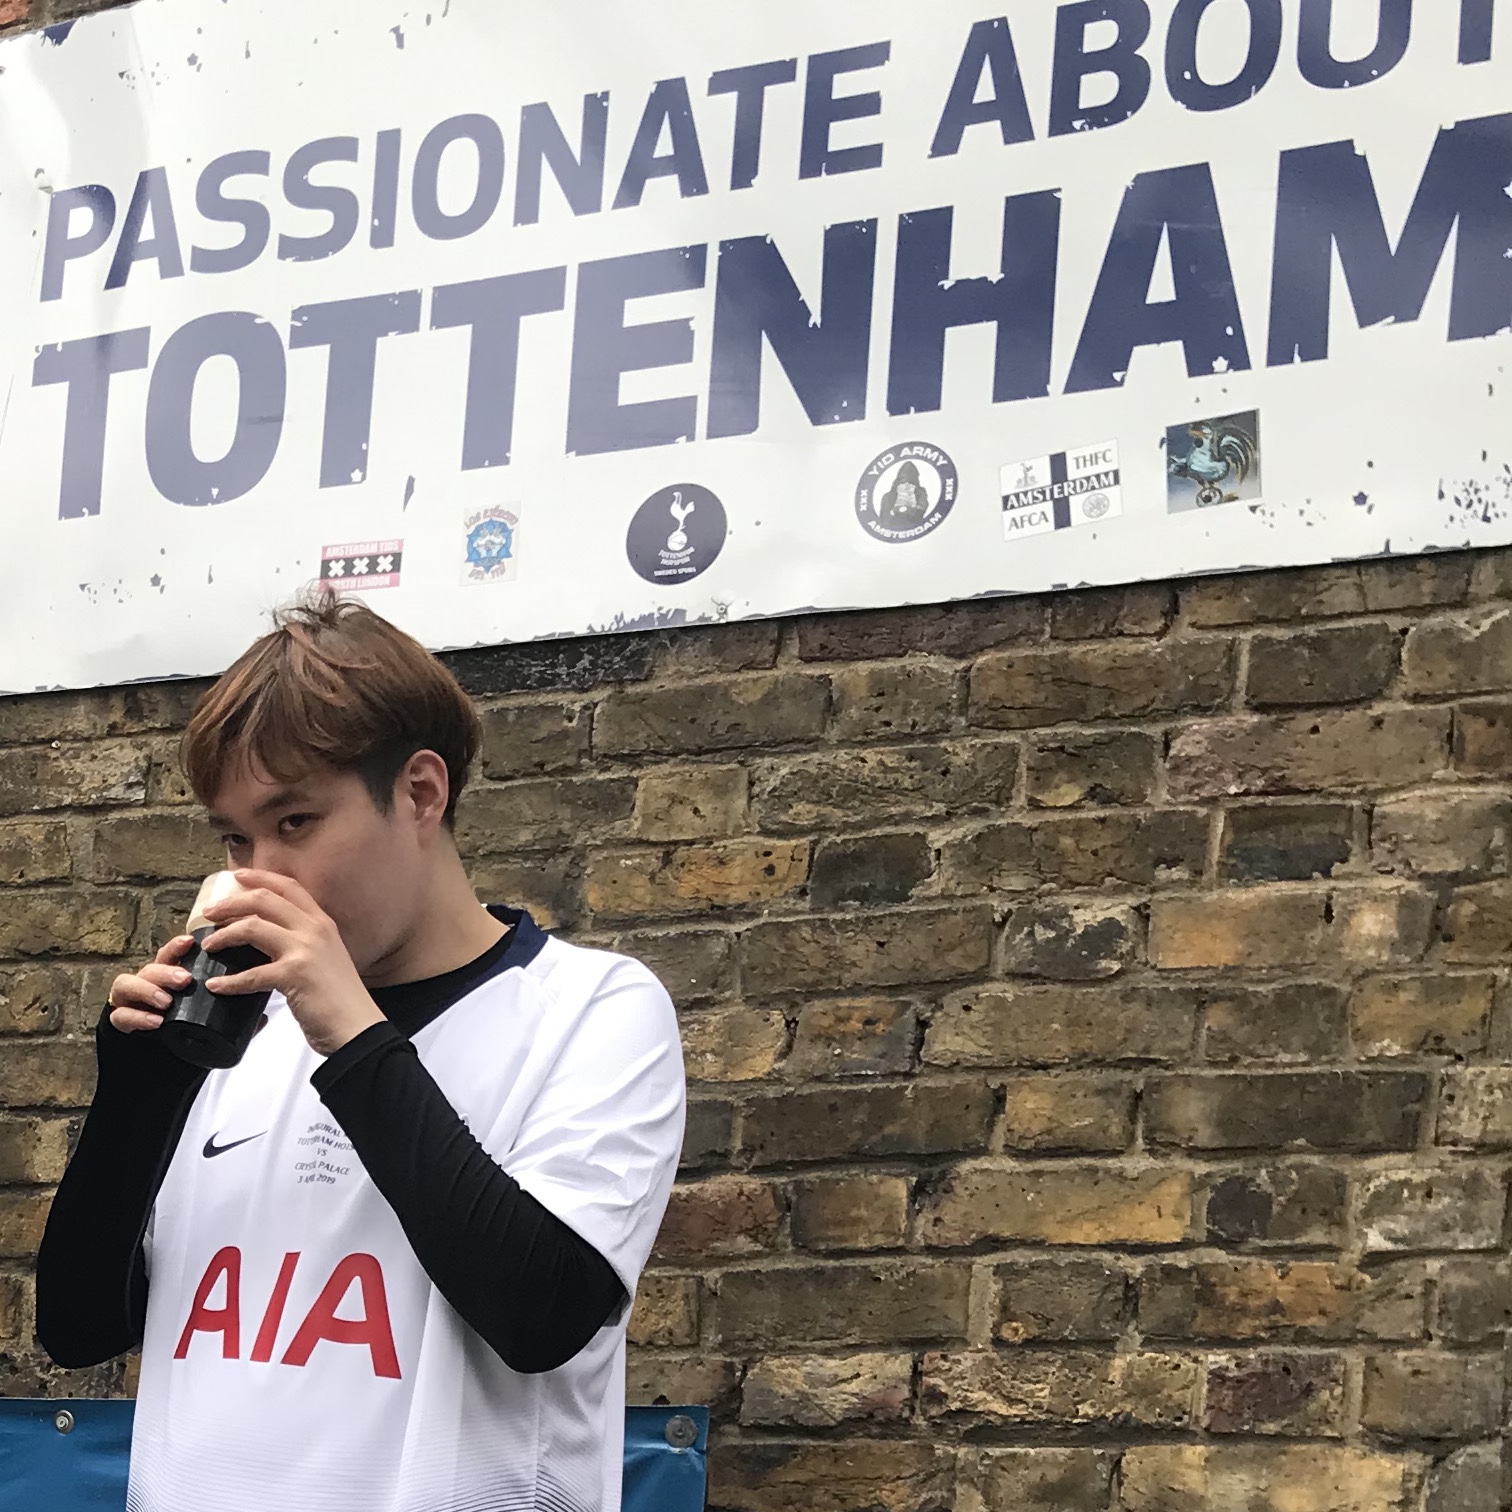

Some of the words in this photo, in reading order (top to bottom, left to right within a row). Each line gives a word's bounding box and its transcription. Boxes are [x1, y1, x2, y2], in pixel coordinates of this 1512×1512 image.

[40, 40, 892, 302] PASSIONATE
[32, 112, 1512, 520] TOTTENHAM
[868, 452, 895, 476] YID
[899, 446, 948, 466] ARMY
[1071, 449, 1113, 471] THFC
[1006, 472, 1116, 510] AMSTERDAM
[867, 512, 942, 539] AMSTERDAM
[1008, 510, 1050, 531] AFCA
[317, 1147, 328, 1157] VS
[297, 1175, 304, 1185] 3
[316, 1174, 336, 1184] 2019
[318, 1161, 350, 1175] PALACE
[173, 1245, 402, 1380] AIA
